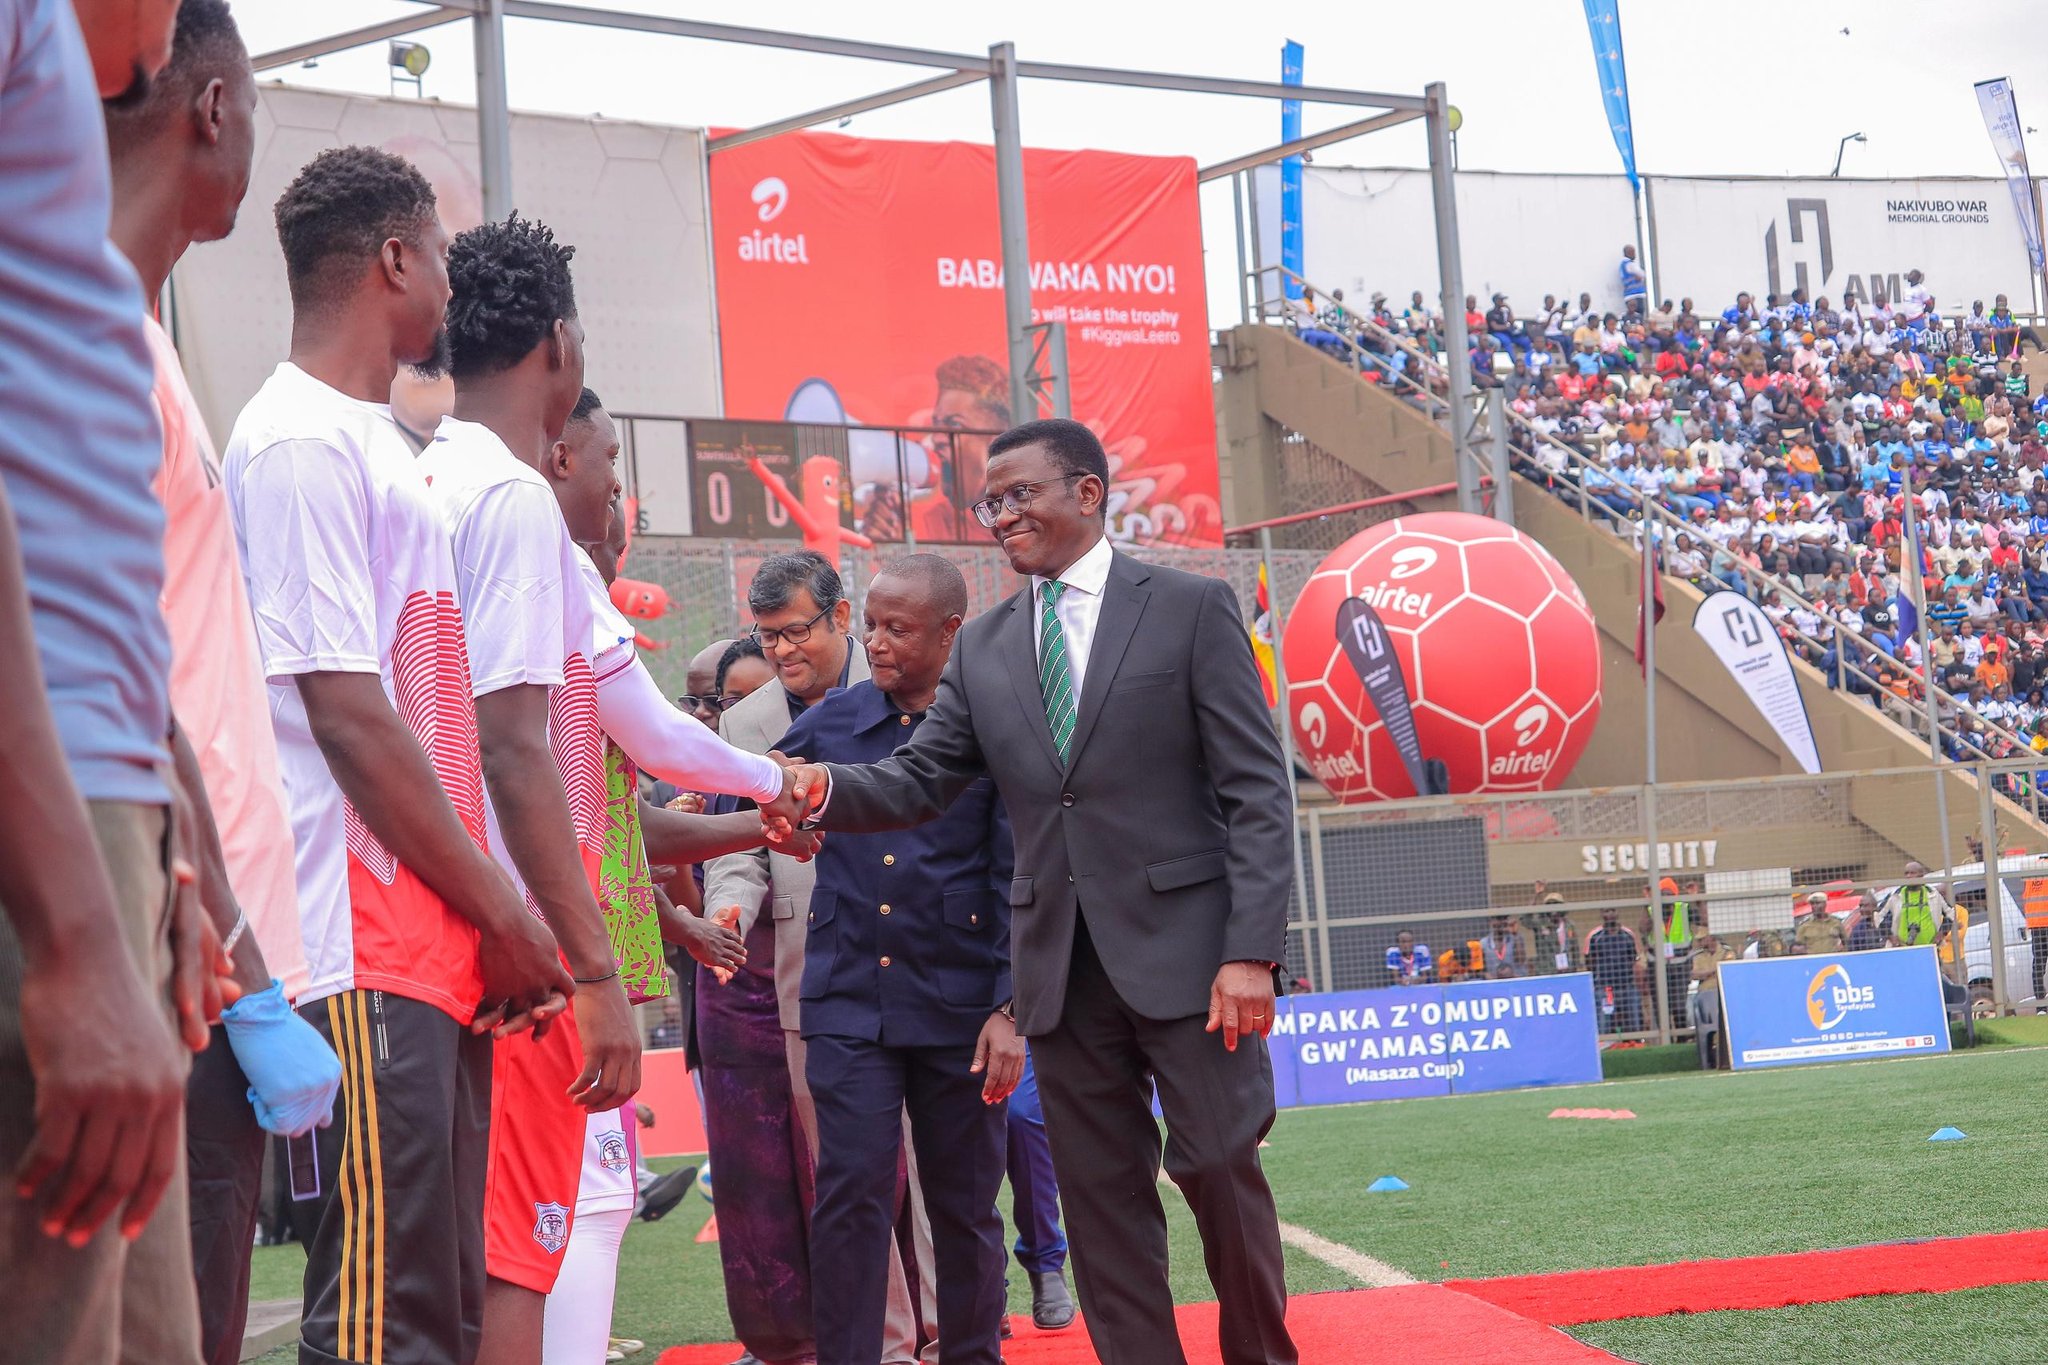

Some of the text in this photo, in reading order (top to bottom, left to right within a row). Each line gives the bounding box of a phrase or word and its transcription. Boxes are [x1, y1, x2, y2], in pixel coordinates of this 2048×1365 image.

[1887, 200, 1987, 212] NAKIVUBO WAR
[1888, 214, 1989, 223] MEMORIAL GROUNDS
[738, 229, 809, 265] airtel
[1106, 263, 1176, 294] NYO!
[1069, 306, 1101, 323] take
[1104, 307, 1128, 323] the
[1131, 308, 1178, 327] trophy
[1358, 580, 1432, 618] airtel
[1490, 749, 1551, 775] airtel
[1833, 985, 1874, 1004] bbs
[1272, 992, 1578, 1036] MPAKA Z'OMUPIIRA
[1301, 1027, 1512, 1065] GW'AMASAZA
[1345, 1058, 1465, 1085] (Masaza Cup)
